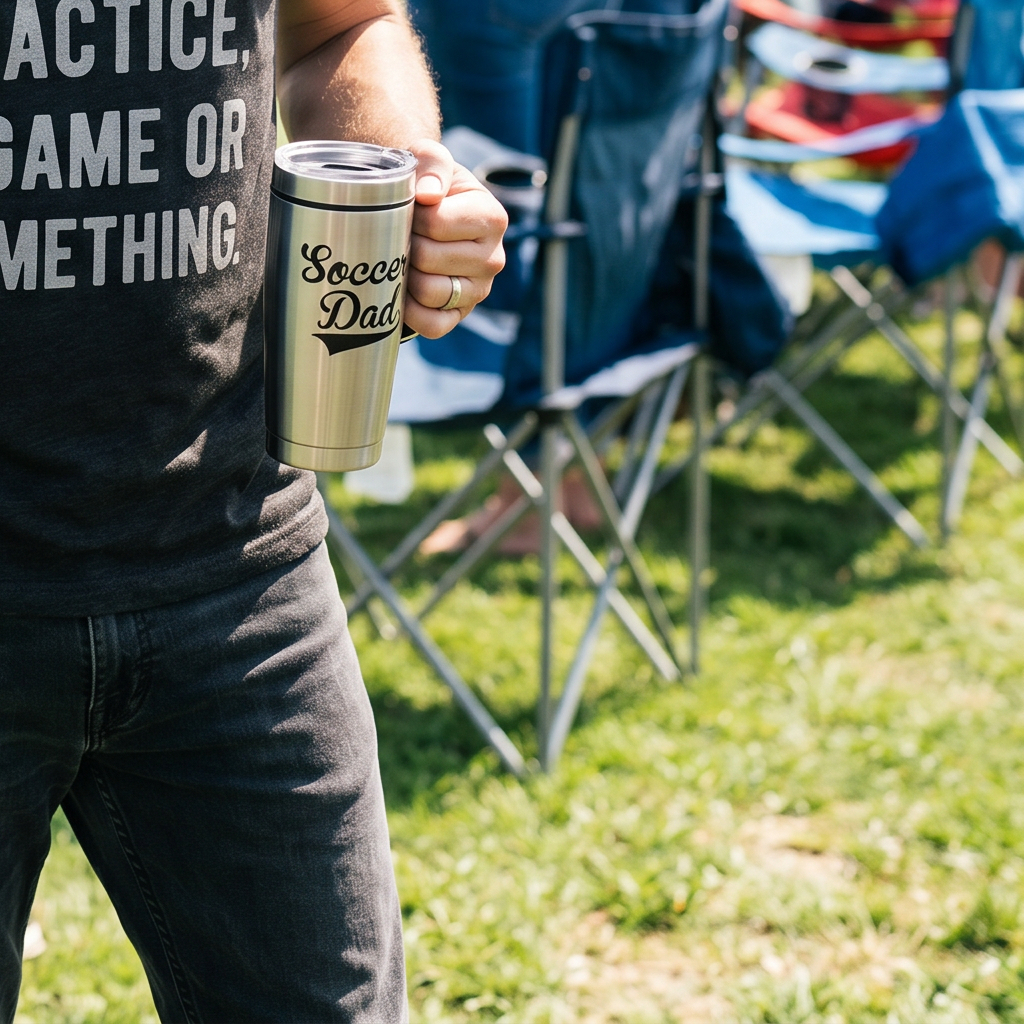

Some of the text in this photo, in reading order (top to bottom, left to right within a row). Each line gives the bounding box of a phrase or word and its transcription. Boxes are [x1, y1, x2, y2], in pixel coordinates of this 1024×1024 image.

[185, 98, 247, 179] OR
[301, 242, 407, 286] Soccer
[317, 282, 401, 330] Dad
